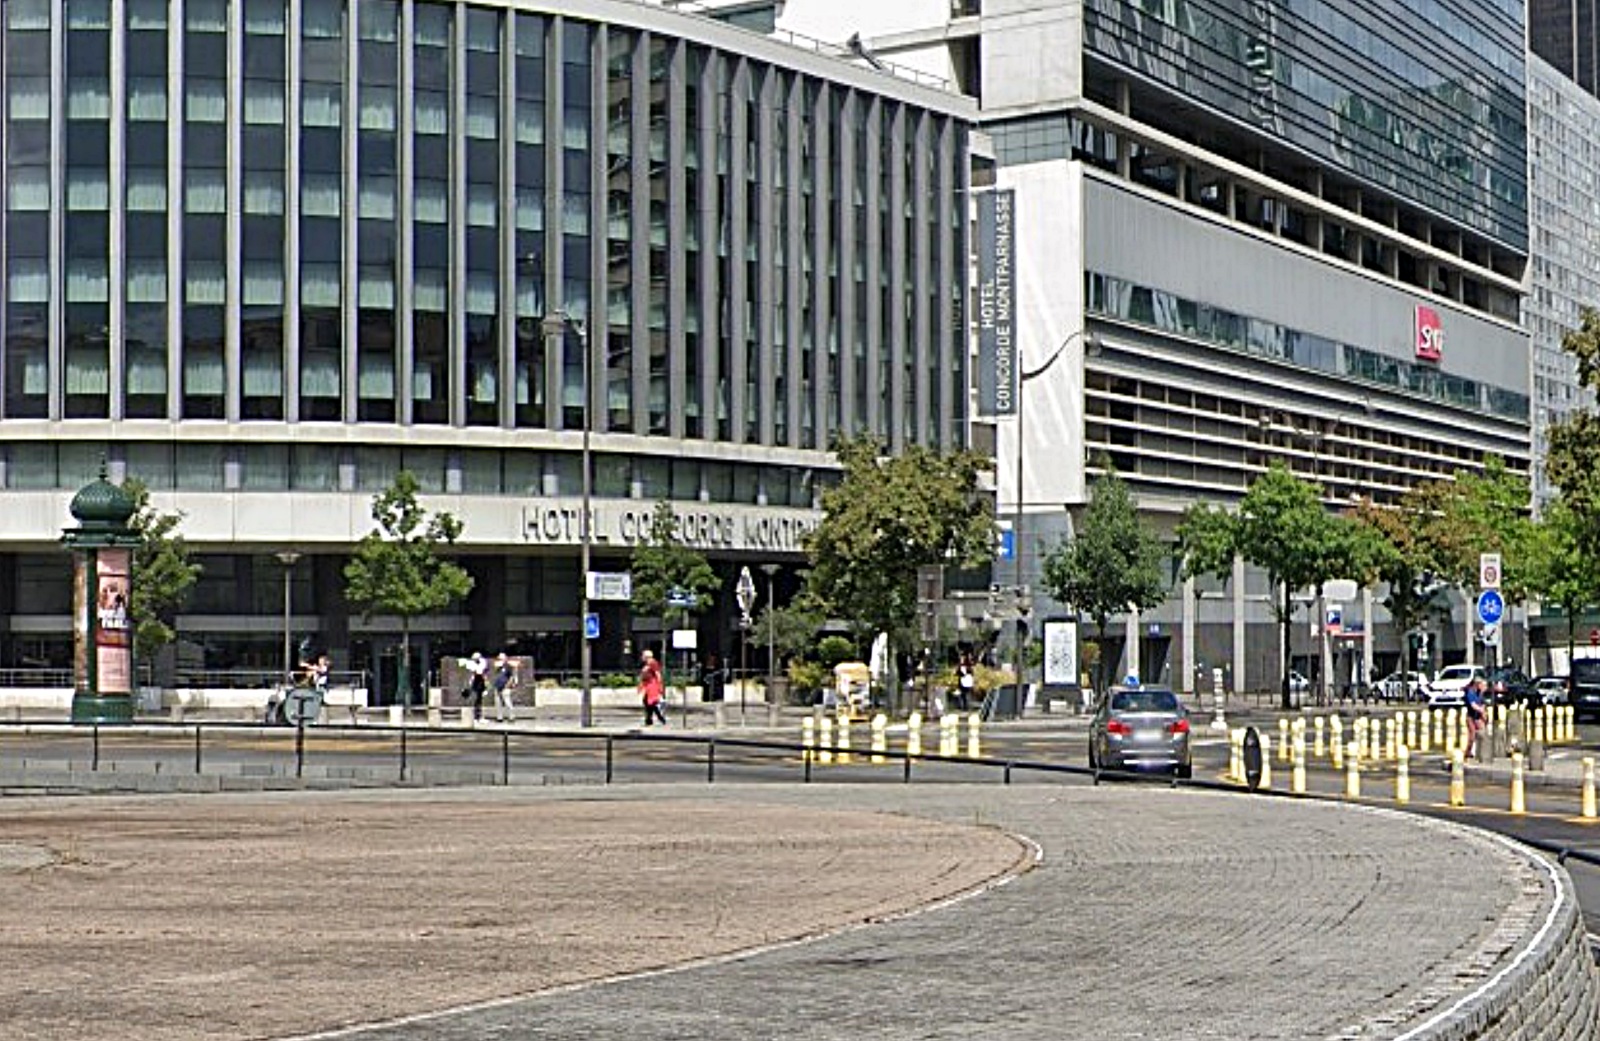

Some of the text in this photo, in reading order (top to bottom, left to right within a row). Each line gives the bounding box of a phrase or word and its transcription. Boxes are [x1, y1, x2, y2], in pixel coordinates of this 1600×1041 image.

[981, 278, 995, 329] HOTEL
[996, 193, 1010, 410] CONCORDE MONTPARNASSE
